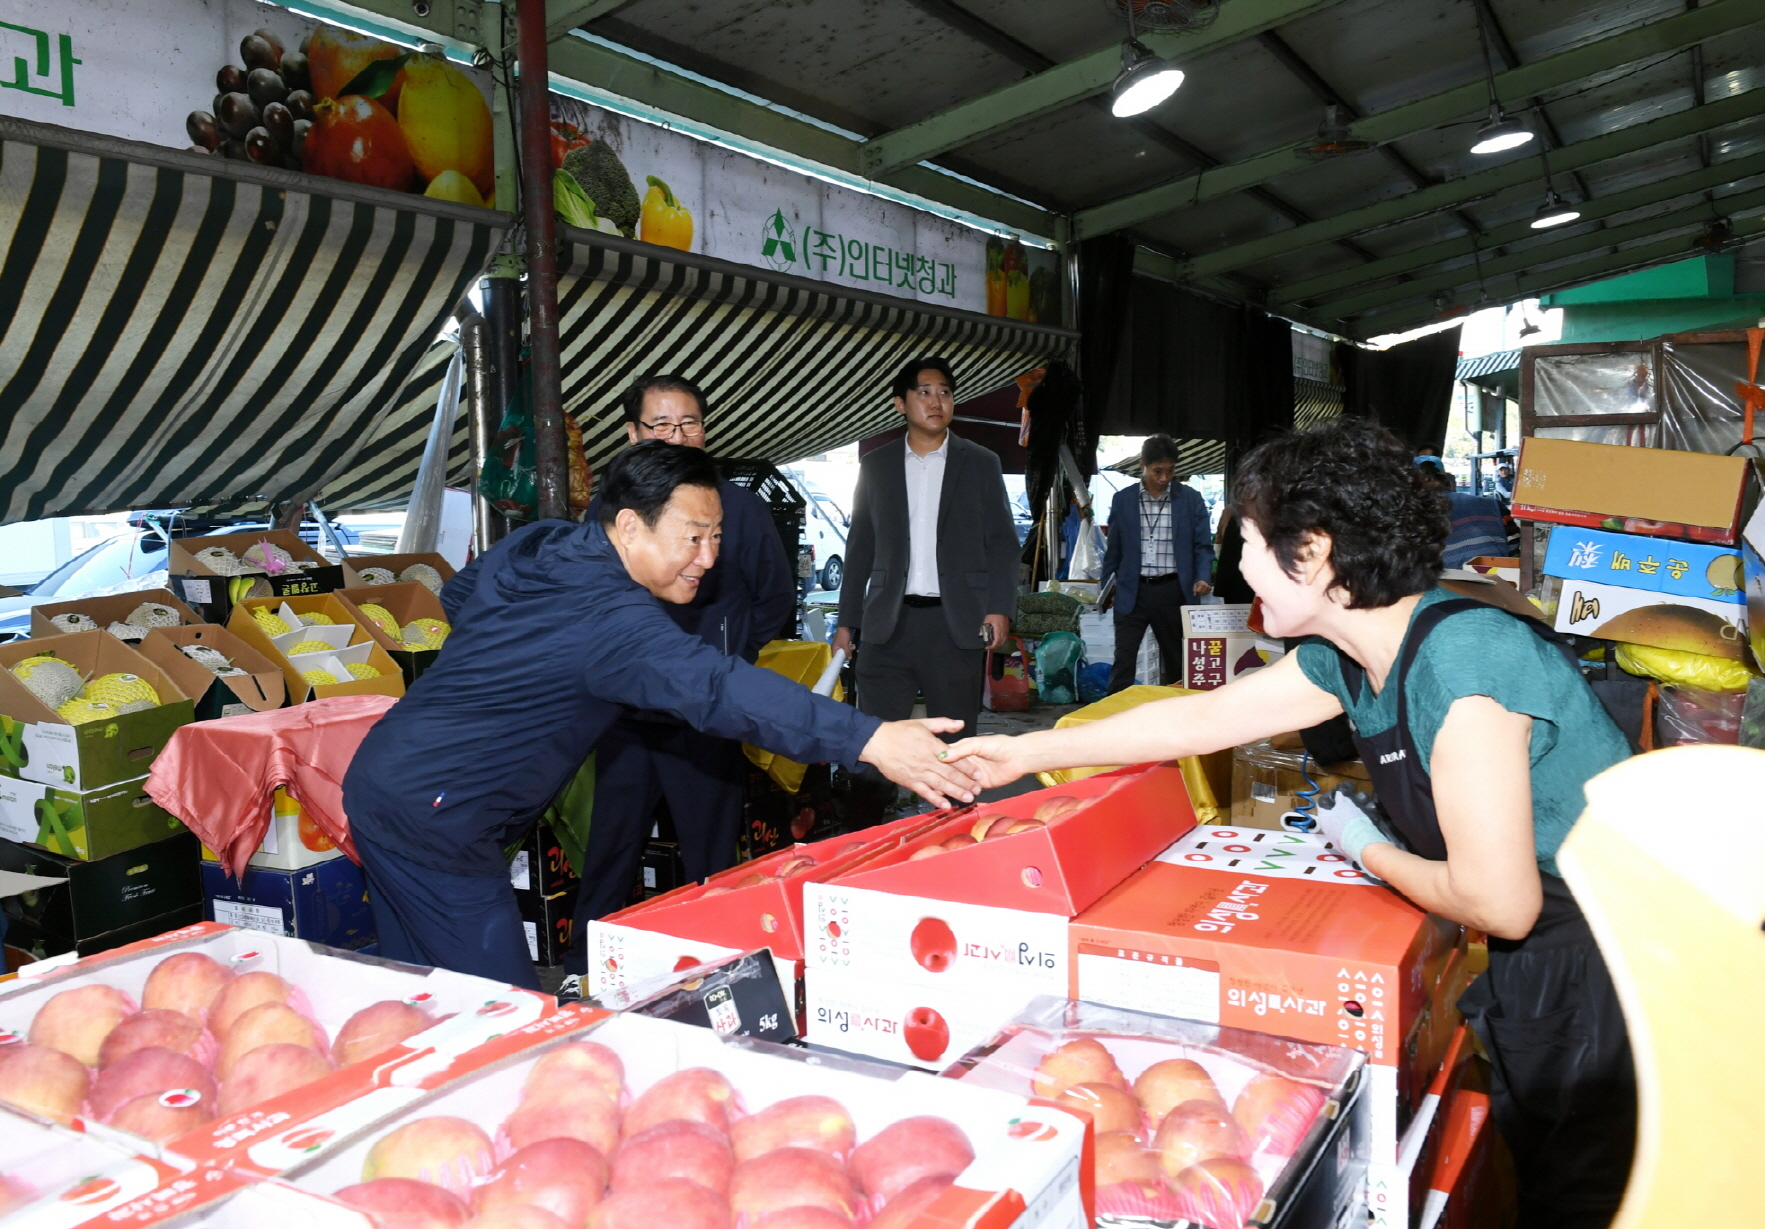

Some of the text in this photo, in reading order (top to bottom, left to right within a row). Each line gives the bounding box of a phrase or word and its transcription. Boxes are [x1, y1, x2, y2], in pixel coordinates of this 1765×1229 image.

[0, 20, 83, 107] 과
[802, 225, 958, 299] (주)인터넷청과
[1207, 640, 1223, 686] 꿀고구
[759, 1013, 778, 1033] 5kg
